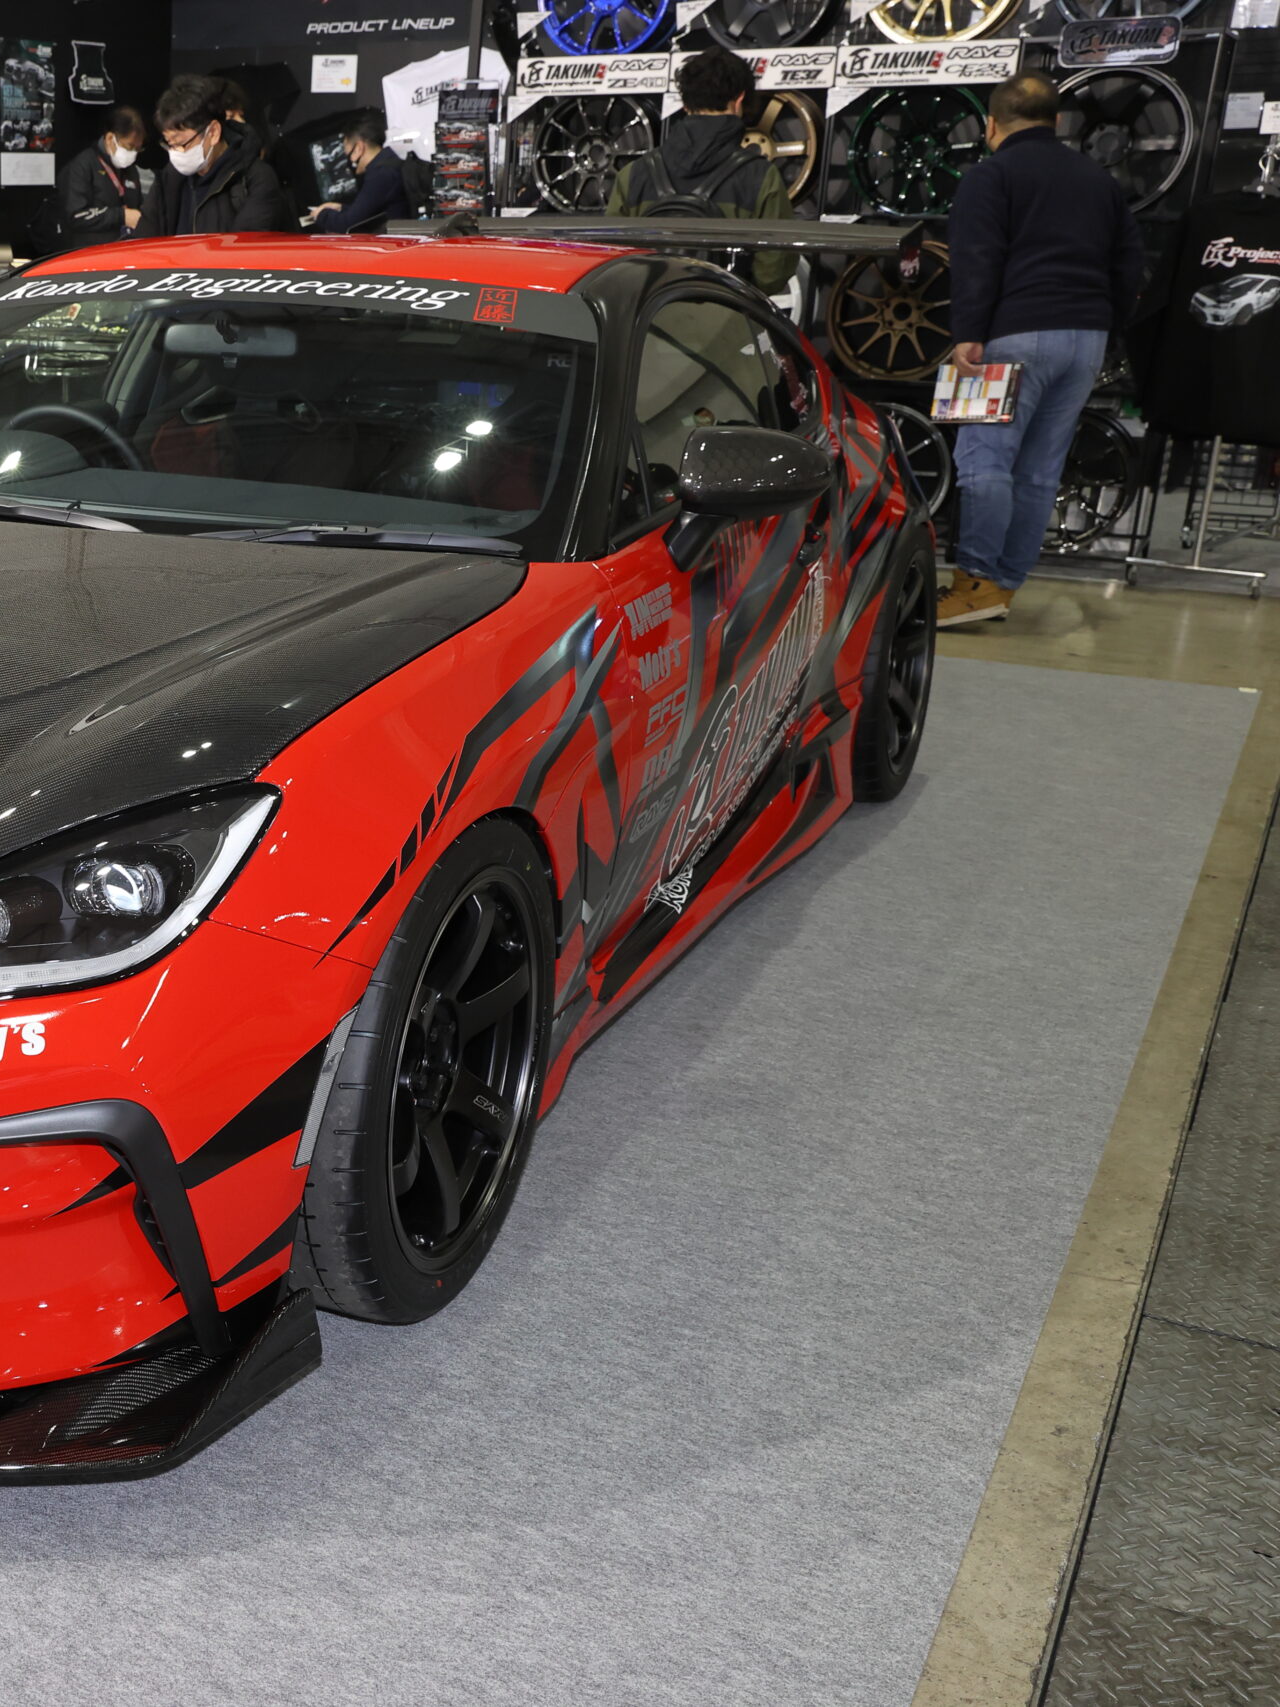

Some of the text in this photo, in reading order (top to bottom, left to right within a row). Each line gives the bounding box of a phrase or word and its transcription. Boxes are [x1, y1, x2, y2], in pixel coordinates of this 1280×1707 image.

[306, 17, 456, 35] PRODUCT LINEUP
[1098, 27, 1163, 45] TAKUMI
[770, 52, 836, 67] RAYS
[870, 50, 937, 69] TAKUMI
[946, 44, 1018, 60] RAYS
[545, 63, 600, 80] TAKUMI
[608, 58, 669, 72] RAYS
[607, 76, 667, 89] ZE40
[781, 68, 823, 81] TE37
[1227, 246, 1280, 263] Projec
[138, 272, 471, 312] Engineering
